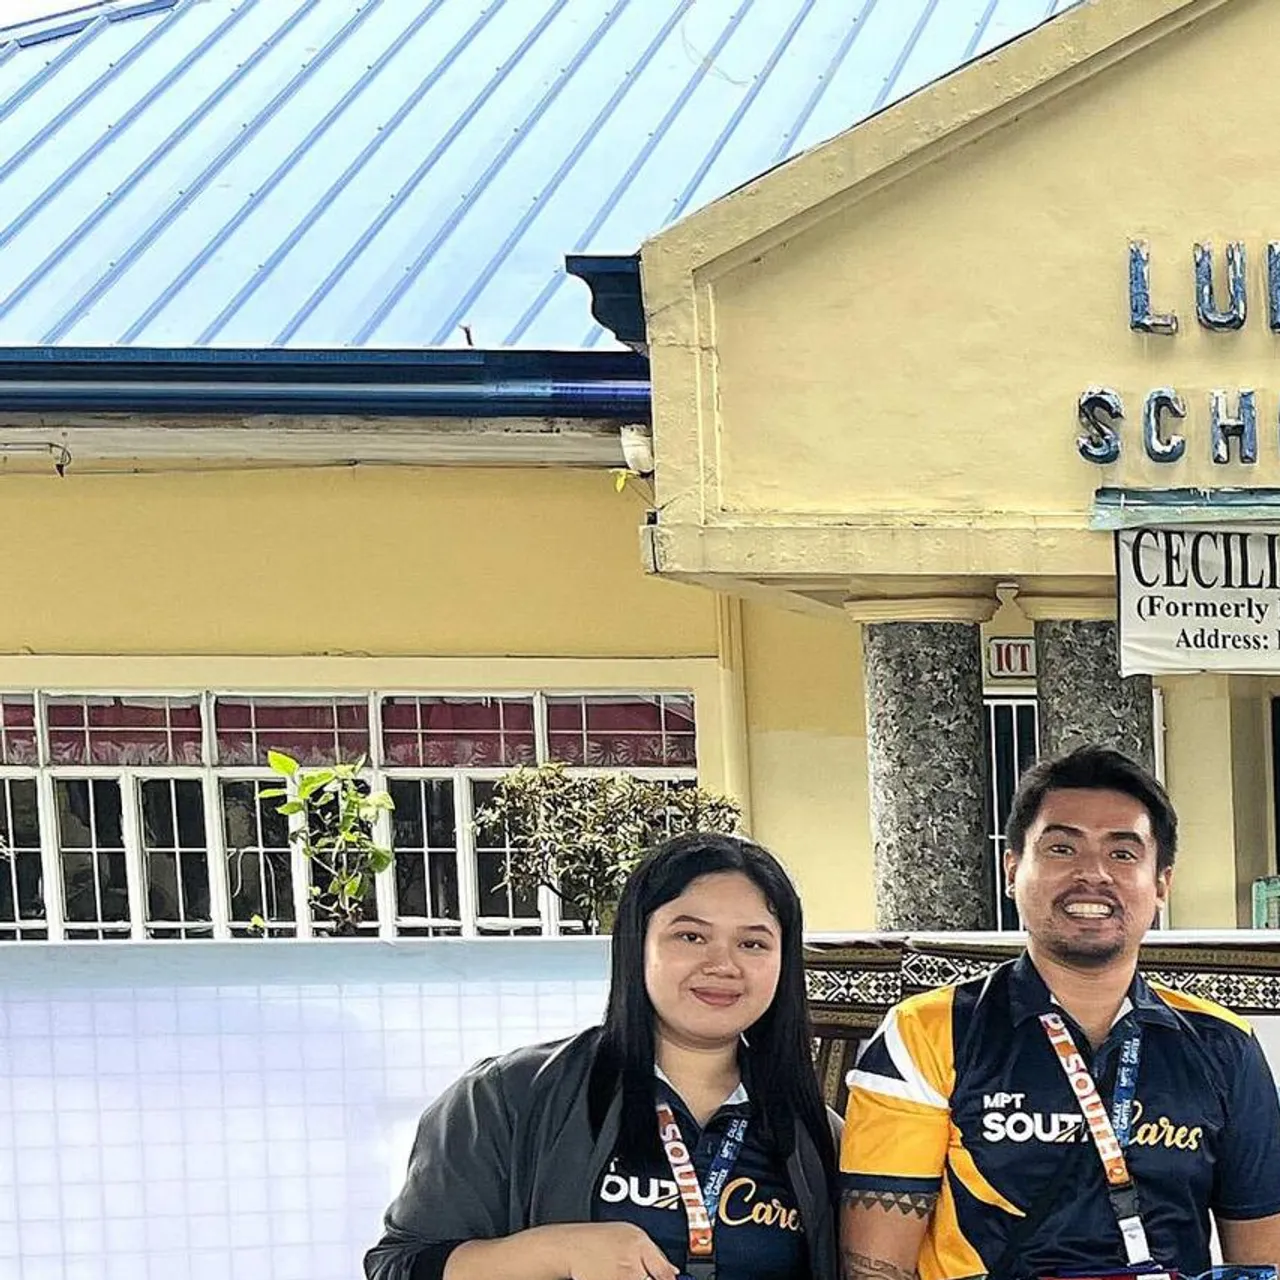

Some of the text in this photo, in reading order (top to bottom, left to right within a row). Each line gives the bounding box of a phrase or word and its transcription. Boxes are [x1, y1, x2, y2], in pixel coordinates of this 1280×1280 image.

[1136, 595, 1268, 624] (Formerly
[1175, 629, 1269, 651] Address:
[994, 643, 1031, 673] ICT
[983, 1092, 1025, 1109] MPT
[982, 1112, 1088, 1143] SOUT
[719, 1177, 804, 1232] Care
